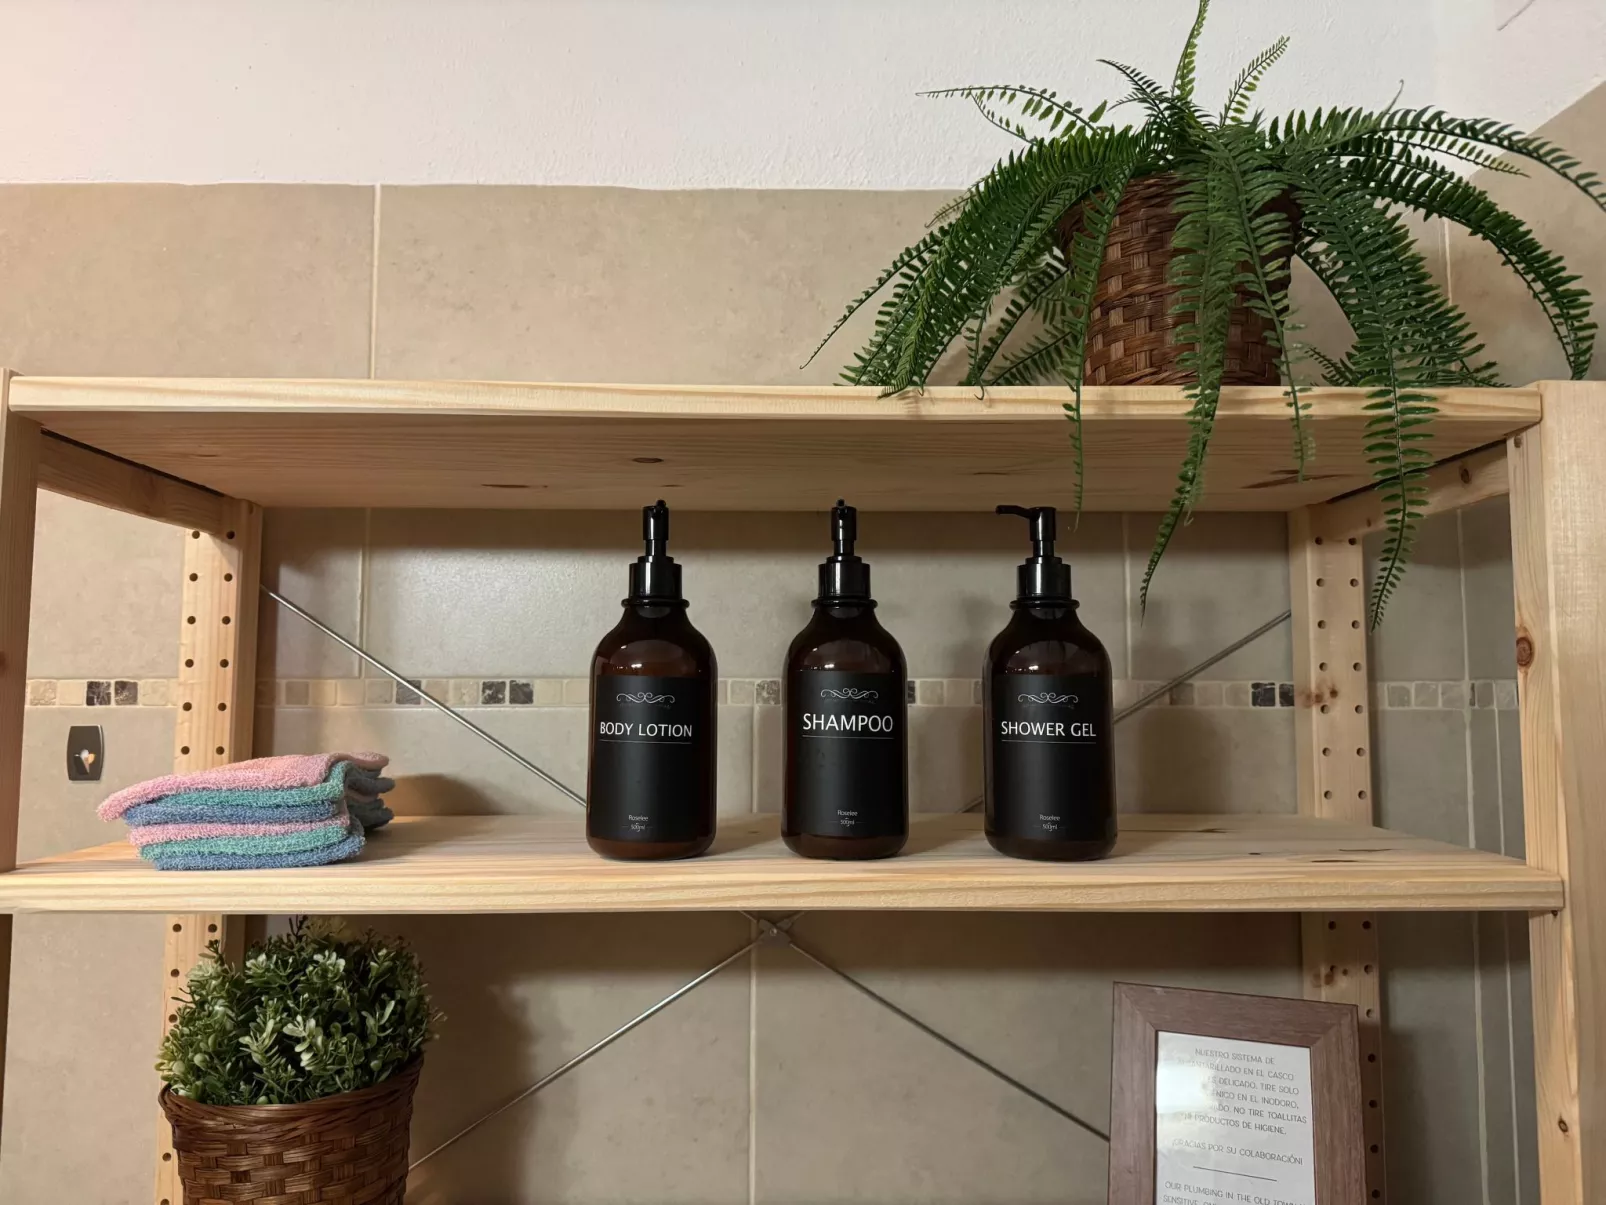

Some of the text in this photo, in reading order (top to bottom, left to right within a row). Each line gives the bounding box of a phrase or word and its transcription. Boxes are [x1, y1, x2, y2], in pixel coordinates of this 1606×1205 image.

[600, 722, 692, 737] BODY LOTION
[803, 713, 893, 732] SHAMPOO
[1001, 721, 1096, 737] SHOWER GEL
[1195, 1048, 1229, 1059] NUESTRO
[1232, 1052, 1262, 1064] SISTEMA
[1244, 1068, 1253, 1076] EN
[1268, 1071, 1294, 1081] CASCO
[1260, 1083, 1276, 1092] TIRE
[1279, 1086, 1299, 1095] SOLO
[1237, 1093, 1247, 1101] EN
[1250, 1095, 1258, 1103] EL
[1262, 1097, 1299, 1109] INODORO,
[1234, 1106, 1245, 1115] NO
[1248, 1108, 1264, 1117] TIRE
[1268, 1111, 1307, 1123] TOALLITAS
[1194, 1114, 1239, 1127] PRODUCTOS
[1255, 1124, 1286, 1135] HIGIENE.
[1208, 1144, 1223, 1152] POR
[1227, 1146, 1237, 1154] SU
[1239, 1149, 1303, 1165] COLABORACIÓN!
[1165, 1181, 1182, 1191] OUR
[1184, 1184, 1223, 1198] PLUMBING
[1226, 1192, 1234, 1200] IN
[1237, 1194, 1251, 1202] THE
[1254, 1196, 1270, 1205] OLD
